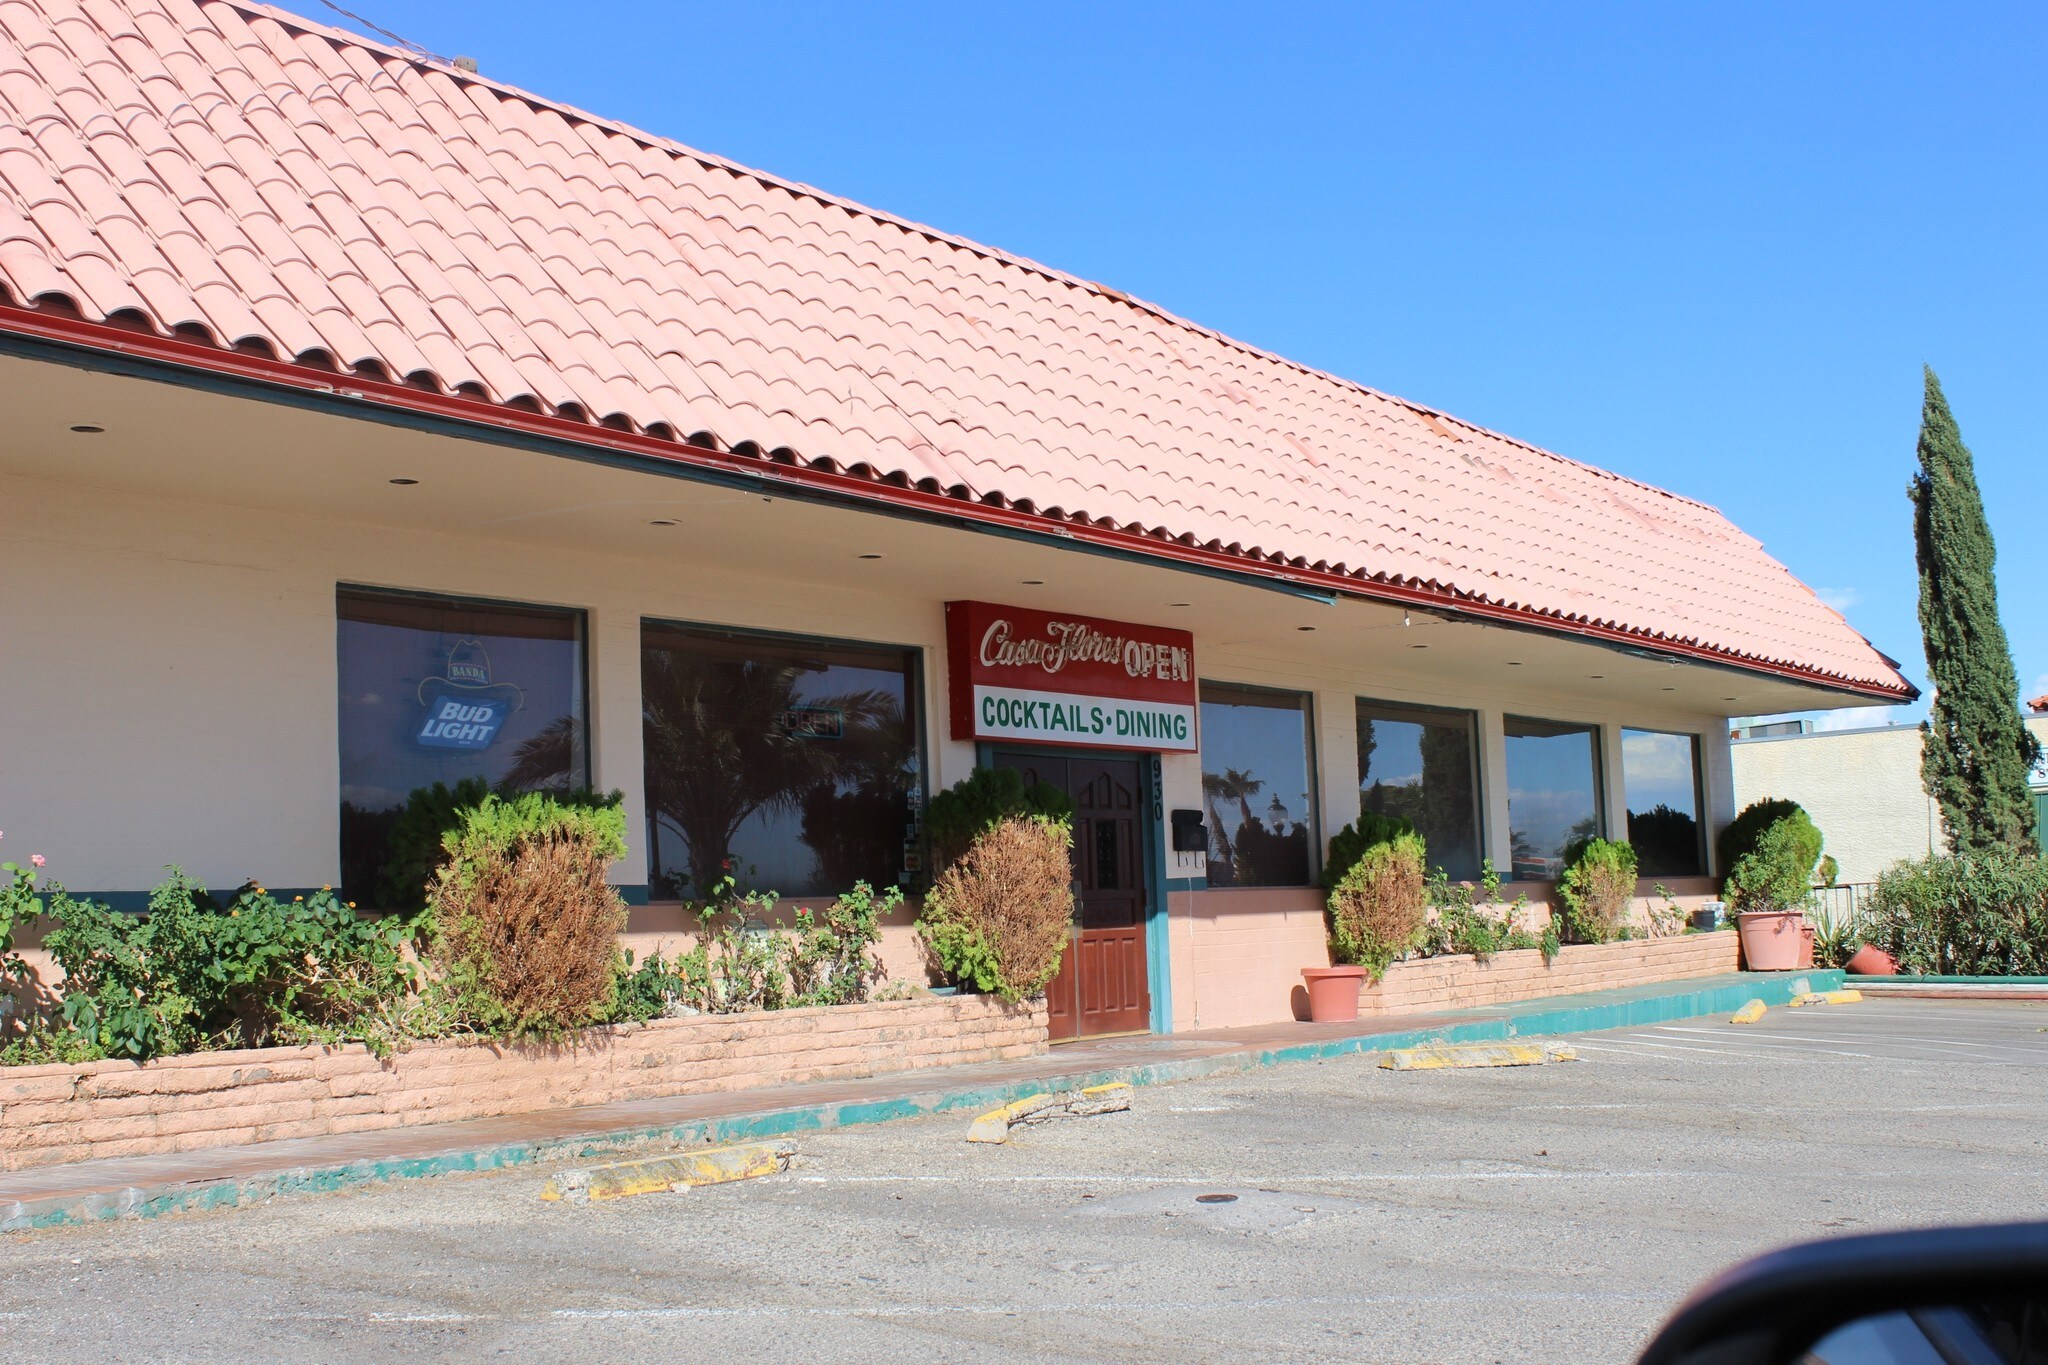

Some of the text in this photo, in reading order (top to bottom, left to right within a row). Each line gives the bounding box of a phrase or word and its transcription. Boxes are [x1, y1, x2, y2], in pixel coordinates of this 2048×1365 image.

[979, 619, 1123, 674] Casa Flores
[1124, 640, 1191, 682] OPEN
[452, 665, 486, 680] BANDA
[420, 719, 494, 741] LIGHT
[438, 702, 493, 723] BUD
[982, 696, 1187, 740] COCKTAILS DINING
[1152, 759, 1163, 822] 930
